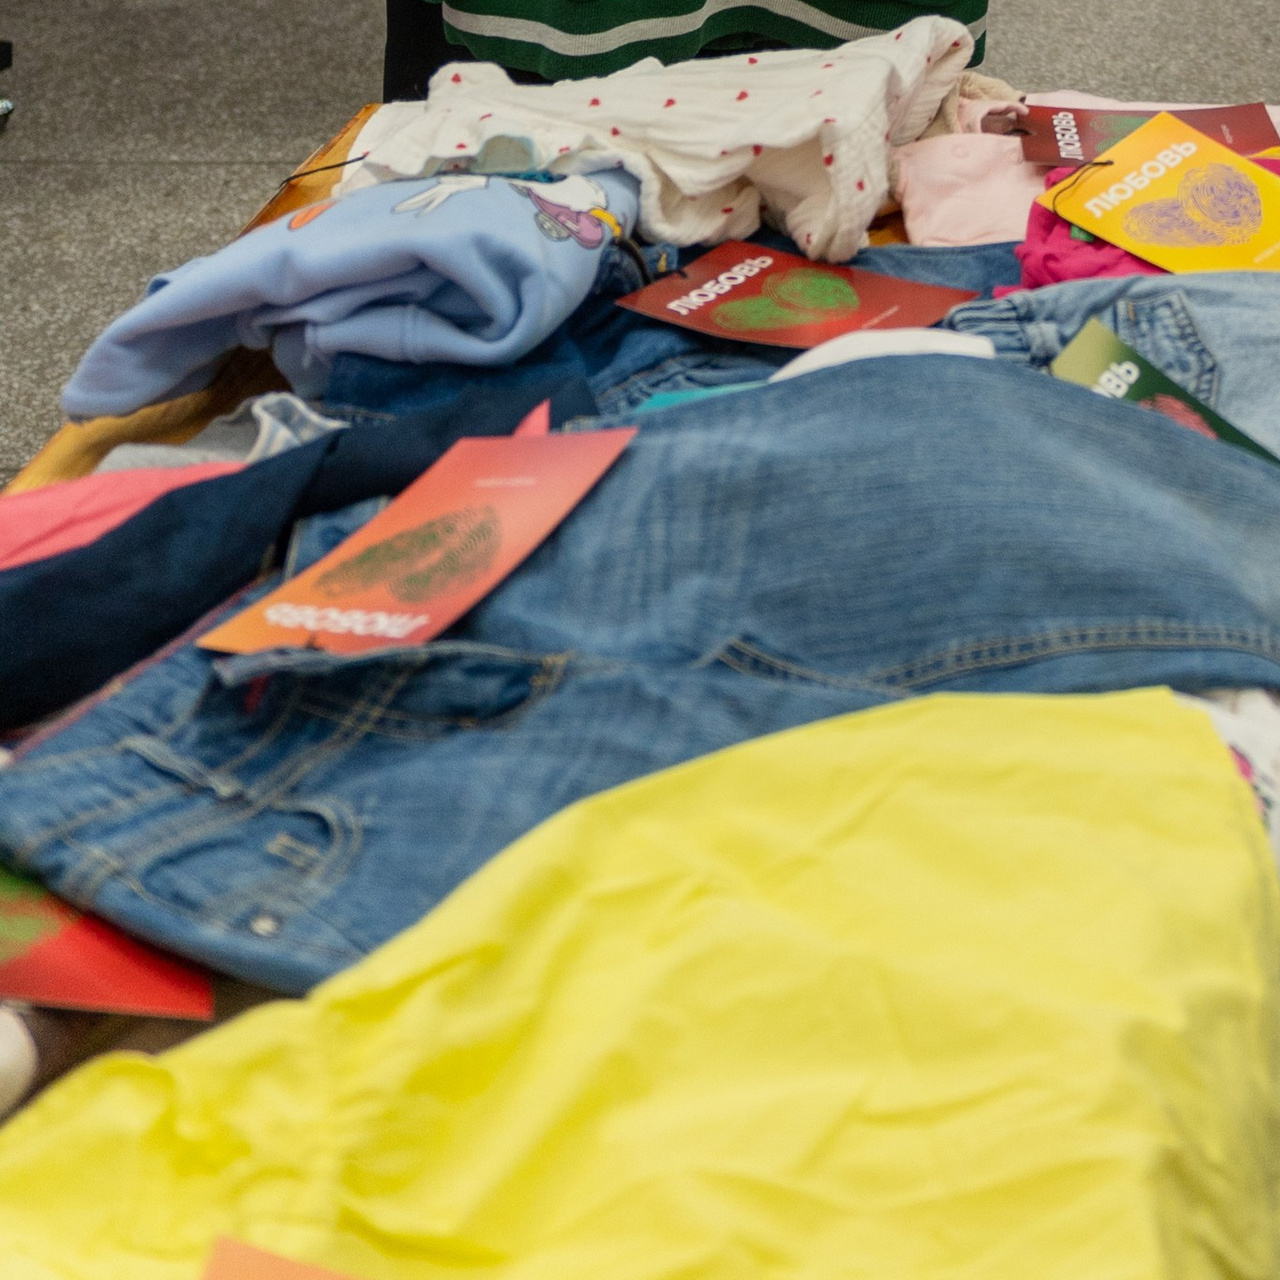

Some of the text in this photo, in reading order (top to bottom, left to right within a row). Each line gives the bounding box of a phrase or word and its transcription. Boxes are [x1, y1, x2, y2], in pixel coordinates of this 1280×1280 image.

[1052, 111, 1084, 160] ЛЮБОВЬ
[1084, 139, 1198, 219] ЛЮБОВЬ
[666, 255, 774, 316] ЛЮБОВЬ
